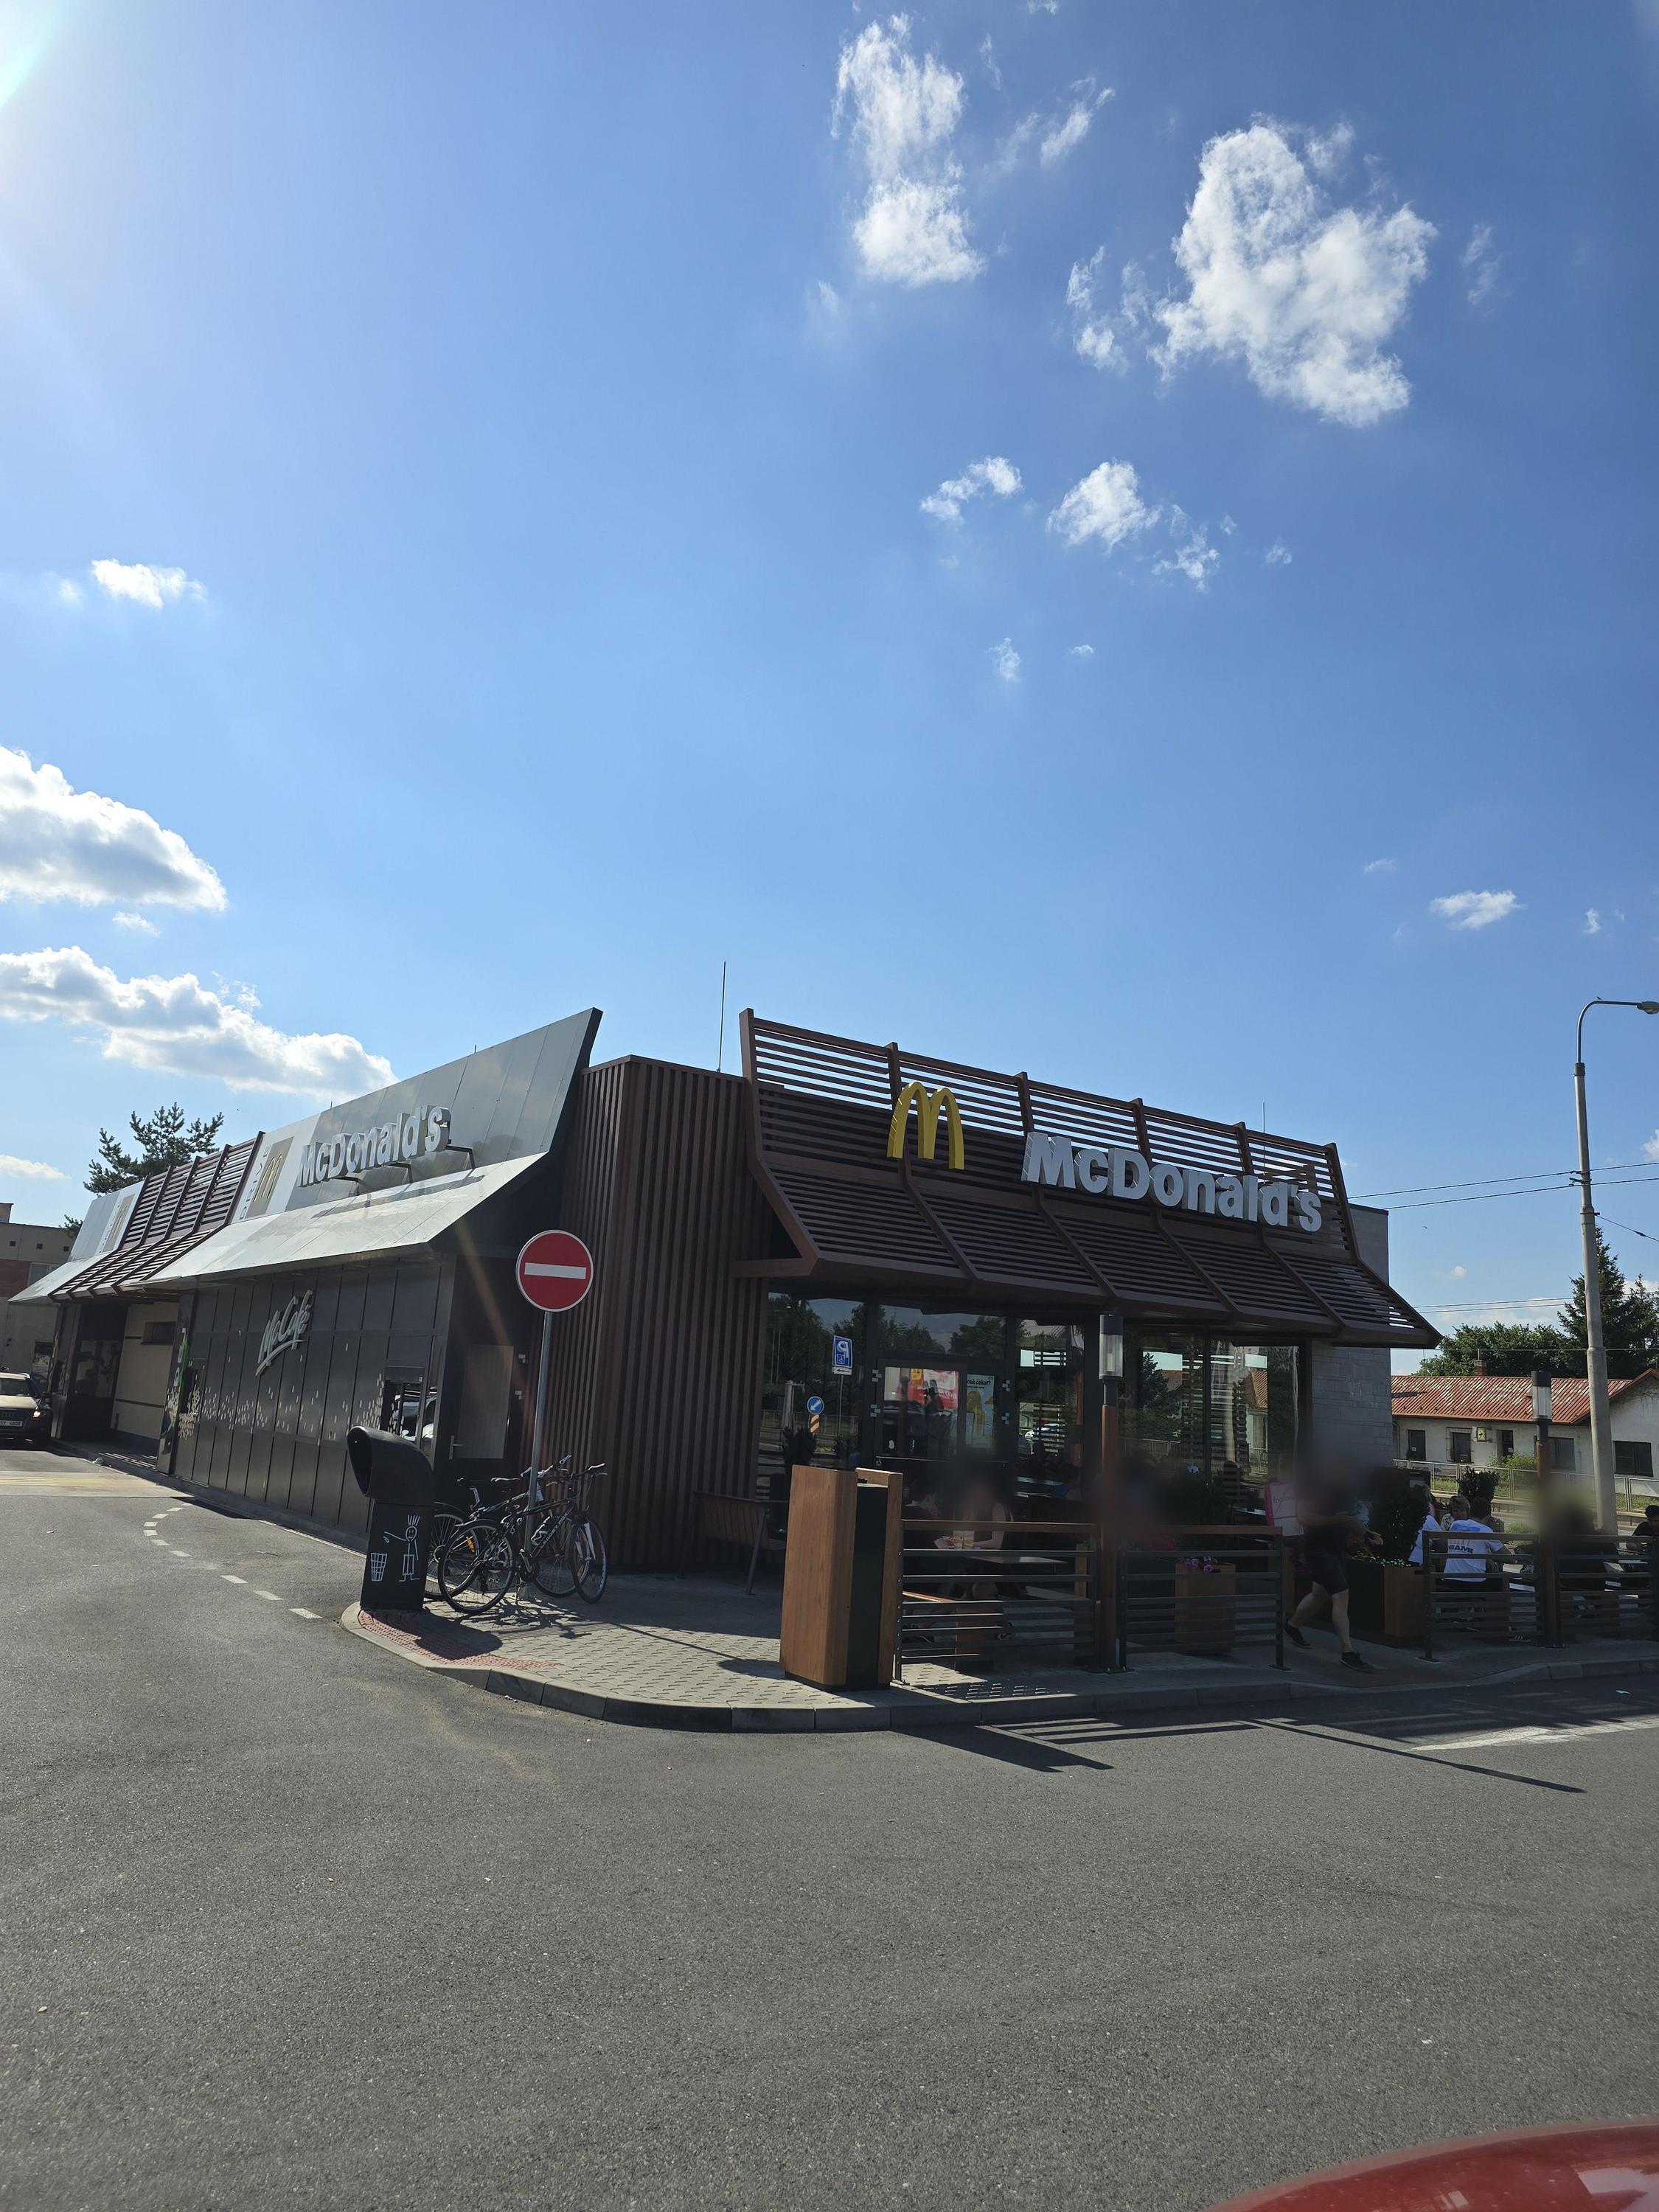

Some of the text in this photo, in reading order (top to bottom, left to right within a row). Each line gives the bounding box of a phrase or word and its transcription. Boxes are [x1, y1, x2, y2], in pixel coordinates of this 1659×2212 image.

[296, 1106, 451, 1186] McDonald's
[1020, 1132, 1322, 1233] McDonald's
[256, 1289, 312, 1368] McCafé
